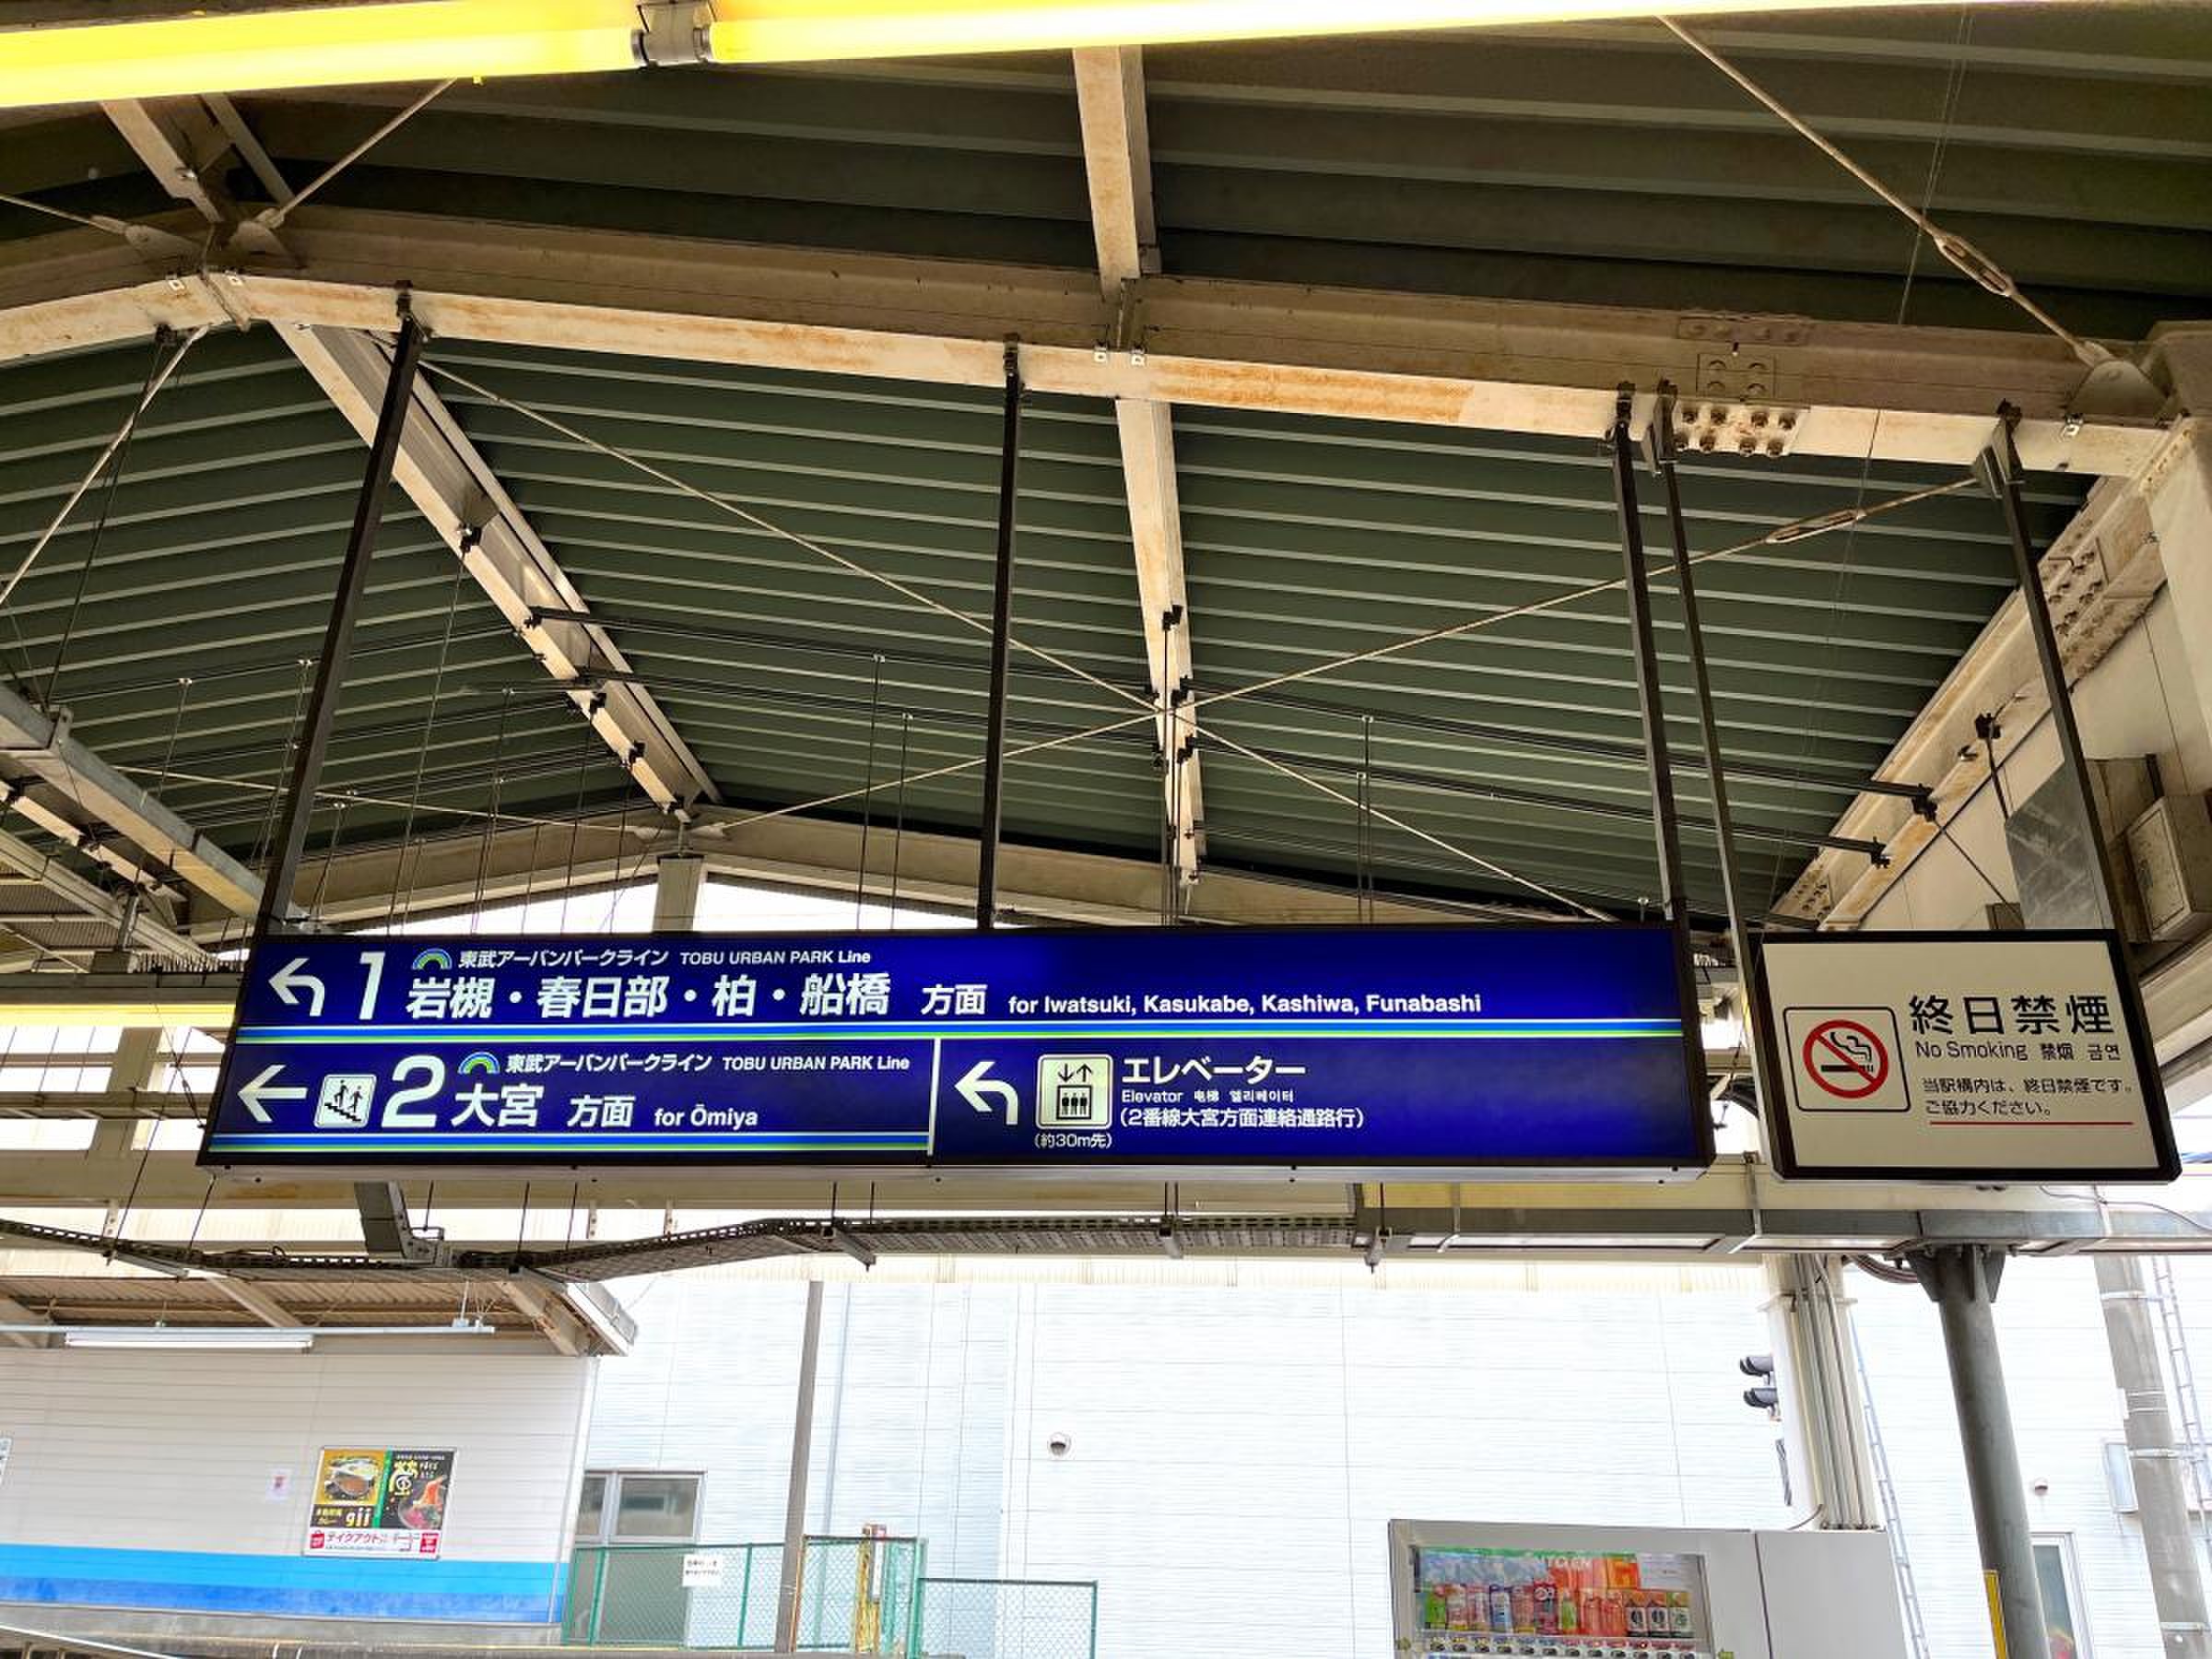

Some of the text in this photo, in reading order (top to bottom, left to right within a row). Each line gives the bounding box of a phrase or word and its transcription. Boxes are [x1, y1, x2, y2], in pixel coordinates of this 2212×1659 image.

[458, 949, 870, 968] 東武アーバンパークライン TOBU URBAN PARK Line
[359, 952, 385, 1019] 1
[921, 984, 987, 1015] 方面
[1008, 996, 1038, 1013] for
[1045, 995, 1135, 1016] Iwatsuki,
[1145, 995, 1253, 1015] Kasukabe,
[1263, 994, 1359, 1015] Kashiwa,
[1367, 994, 1481, 1012] Funabashi
[1909, 995, 2114, 1034] 終日禁煙
[506, 1053, 910, 1073] 東武アーバンパークライン TOBU URBAN PARK Line
[1915, 1041, 1941, 1057] No
[1947, 1041, 2028, 1061] Smoking
[2088, 1044, 2120, 1061] 금연
[1123, 1056, 1305, 1084] エレベーター
[382, 1055, 445, 1127] 2
[1122, 1089, 1183, 1102] Elevator
[1924, 1078, 2131, 1093] 当駅構内は、終日禁煙です。
[451, 1083, 758, 1130] 大宮 方面 for Ōmiya
[1926, 1100, 2050, 1115] ご協力ください。
